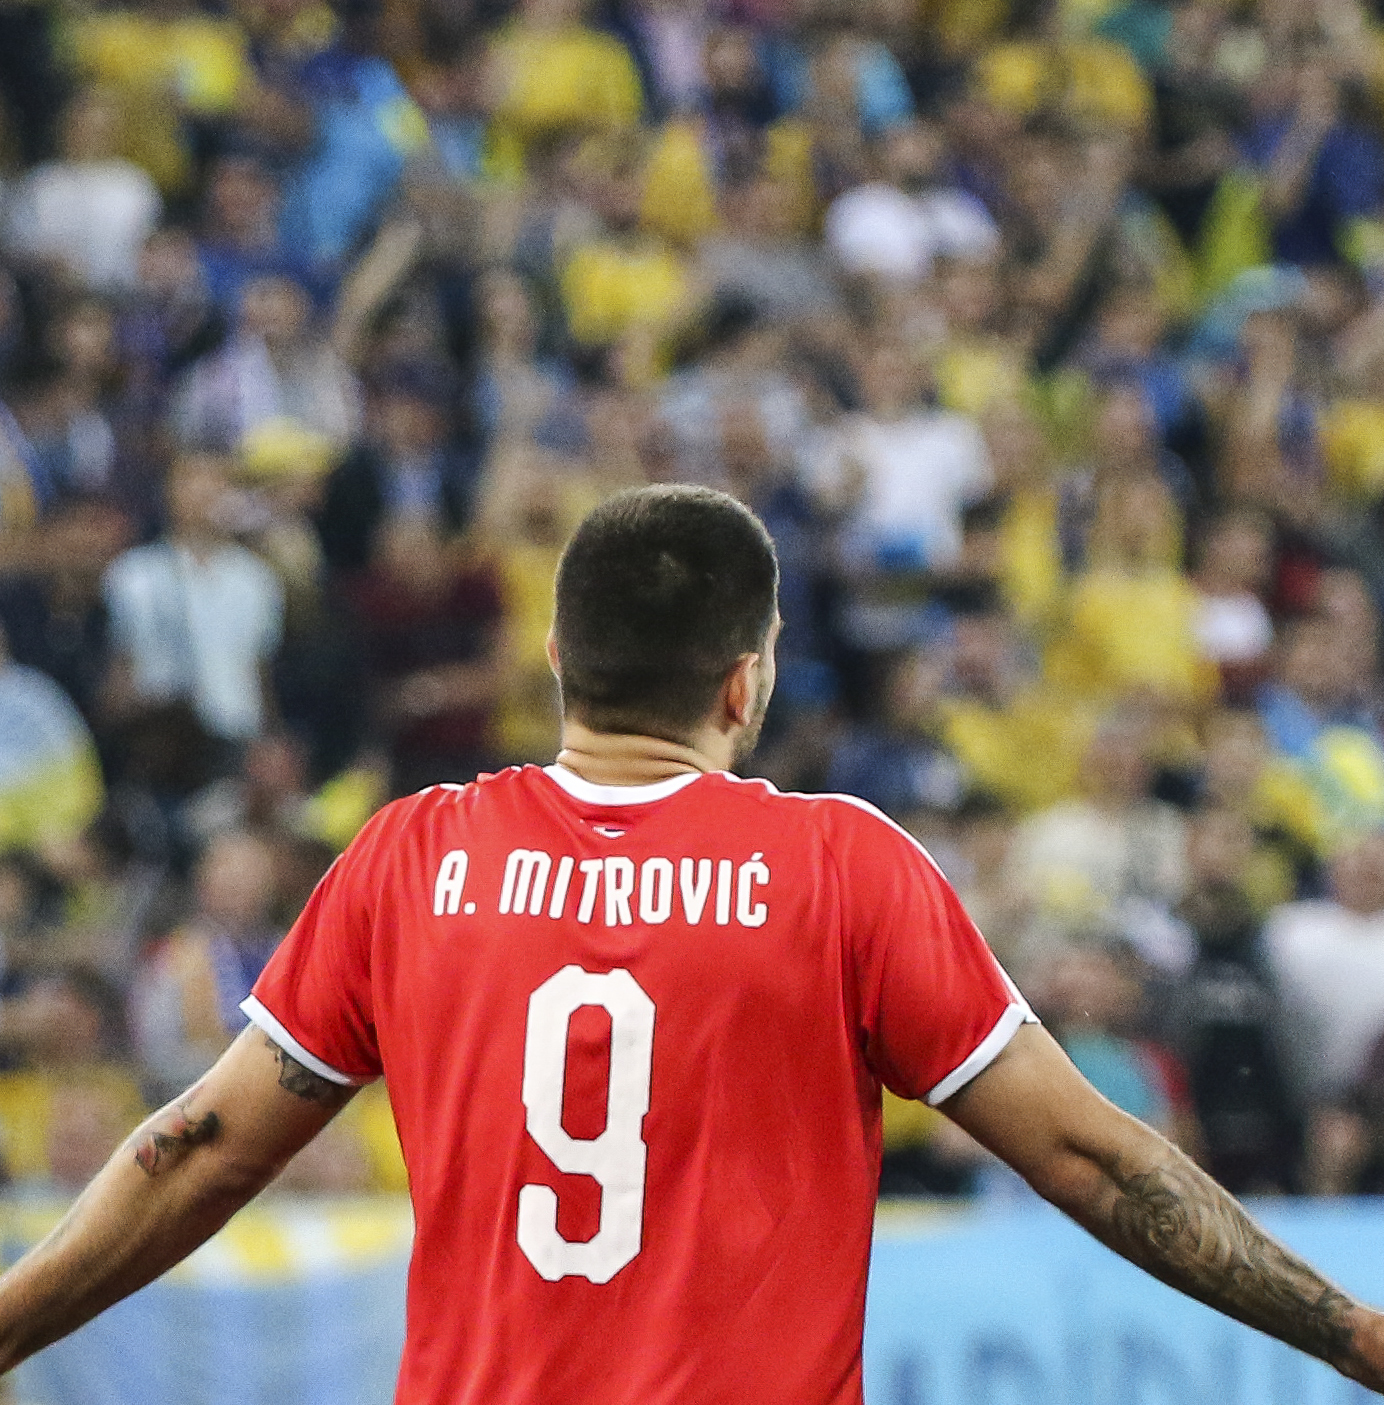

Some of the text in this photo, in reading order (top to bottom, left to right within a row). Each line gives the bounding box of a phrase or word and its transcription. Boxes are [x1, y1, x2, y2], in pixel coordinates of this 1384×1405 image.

[432, 848, 771, 929] A. MITROVIĆ
[516, 963, 657, 1286] 9
